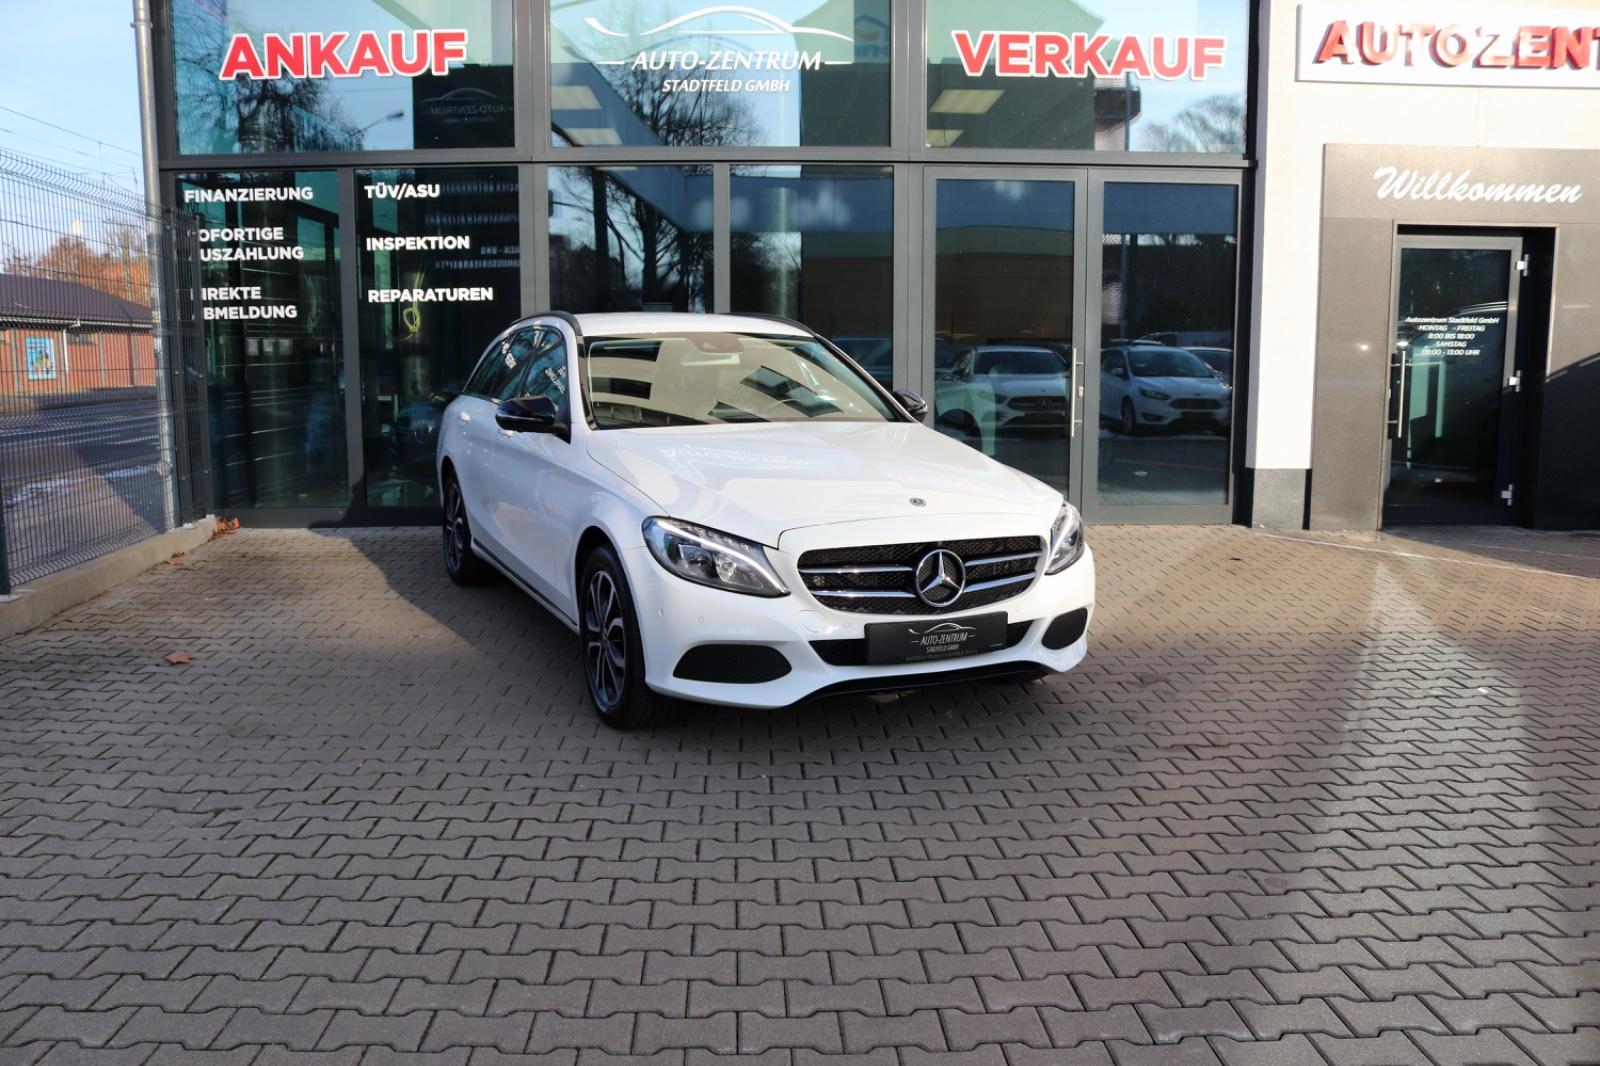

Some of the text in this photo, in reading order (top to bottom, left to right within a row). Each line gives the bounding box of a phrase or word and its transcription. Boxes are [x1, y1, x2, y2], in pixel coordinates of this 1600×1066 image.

[219, 29, 468, 80] ANKAUF
[631, 50, 822, 71] AUTO-ZENTRUM
[951, 30, 1227, 80] VERKAUF
[662, 79, 791, 92] STADTFELD GMBH
[364, 182, 441, 200] TÜV/ASU
[1373, 166, 1585, 204] Willkommen
[184, 186, 314, 203] FINANZIERUNG
[198, 226, 285, 243] OFORTIGE
[366, 235, 471, 251] INSPEKTION
[200, 246, 305, 262] USZAHLUNG
[201, 286, 262, 301] IREKTE
[367, 287, 494, 303] REPARATUREN
[203, 304, 298, 321] BMELDUNG
